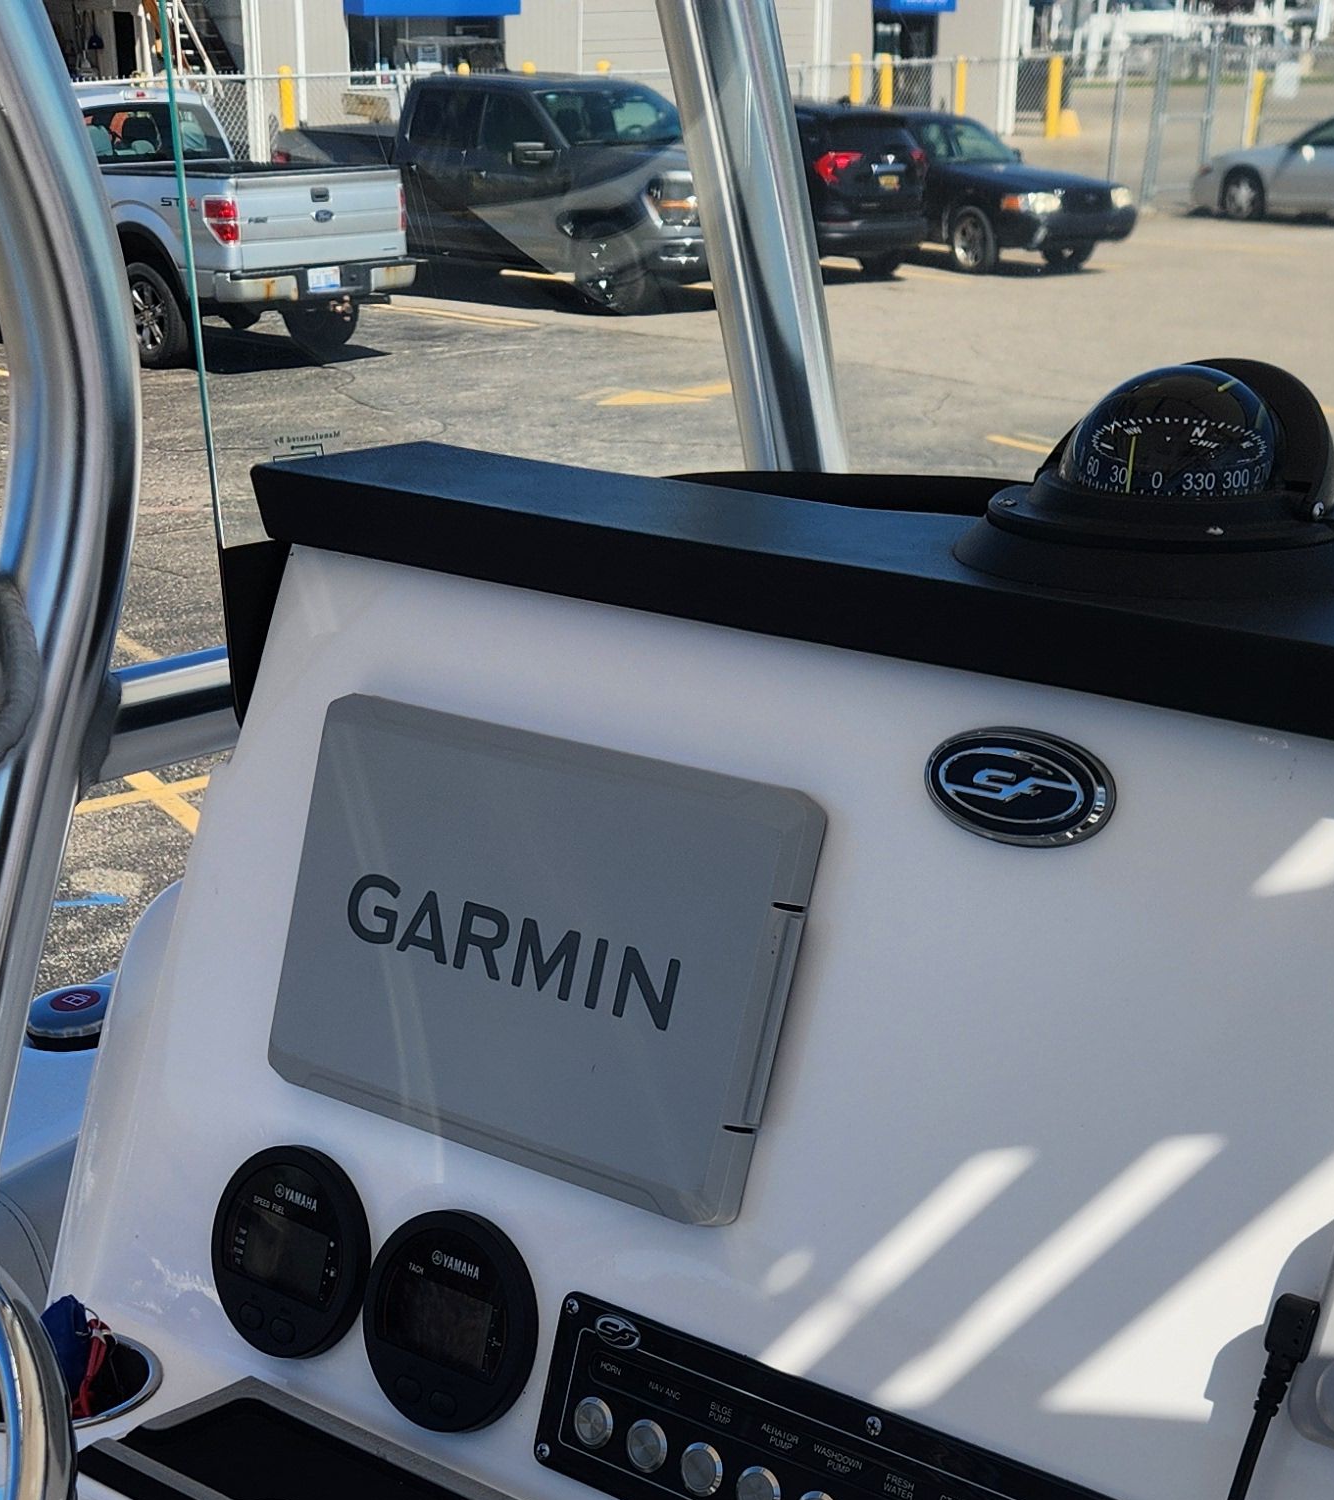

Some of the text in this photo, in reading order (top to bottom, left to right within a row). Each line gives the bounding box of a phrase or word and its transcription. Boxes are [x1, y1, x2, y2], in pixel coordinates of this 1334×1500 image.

[1109, 465, 1128, 485] 30
[1182, 472, 1216, 491] 330
[1222, 468, 1250, 490] 300
[347, 873, 681, 1031] GARMIN
[284, 1187, 318, 1212] YAMAHA
[271, 1203, 285, 1215] FUEL
[408, 1262, 424, 1275] TACH
[442, 1258, 480, 1280] YAMAHA
[600, 1361, 622, 1376] HORN
[710, 1401, 733, 1417] BILGE
[708, 1412, 731, 1425] PUMP
[761, 1423, 799, 1445] AERATOR
[769, 1436, 793, 1451] PUMP
[813, 1443, 863, 1471] WASHDOWN
[826, 1459, 851, 1474] PUMP
[885, 1473, 915, 1490] FRESH
[883, 1482, 914, 1500] WATER
